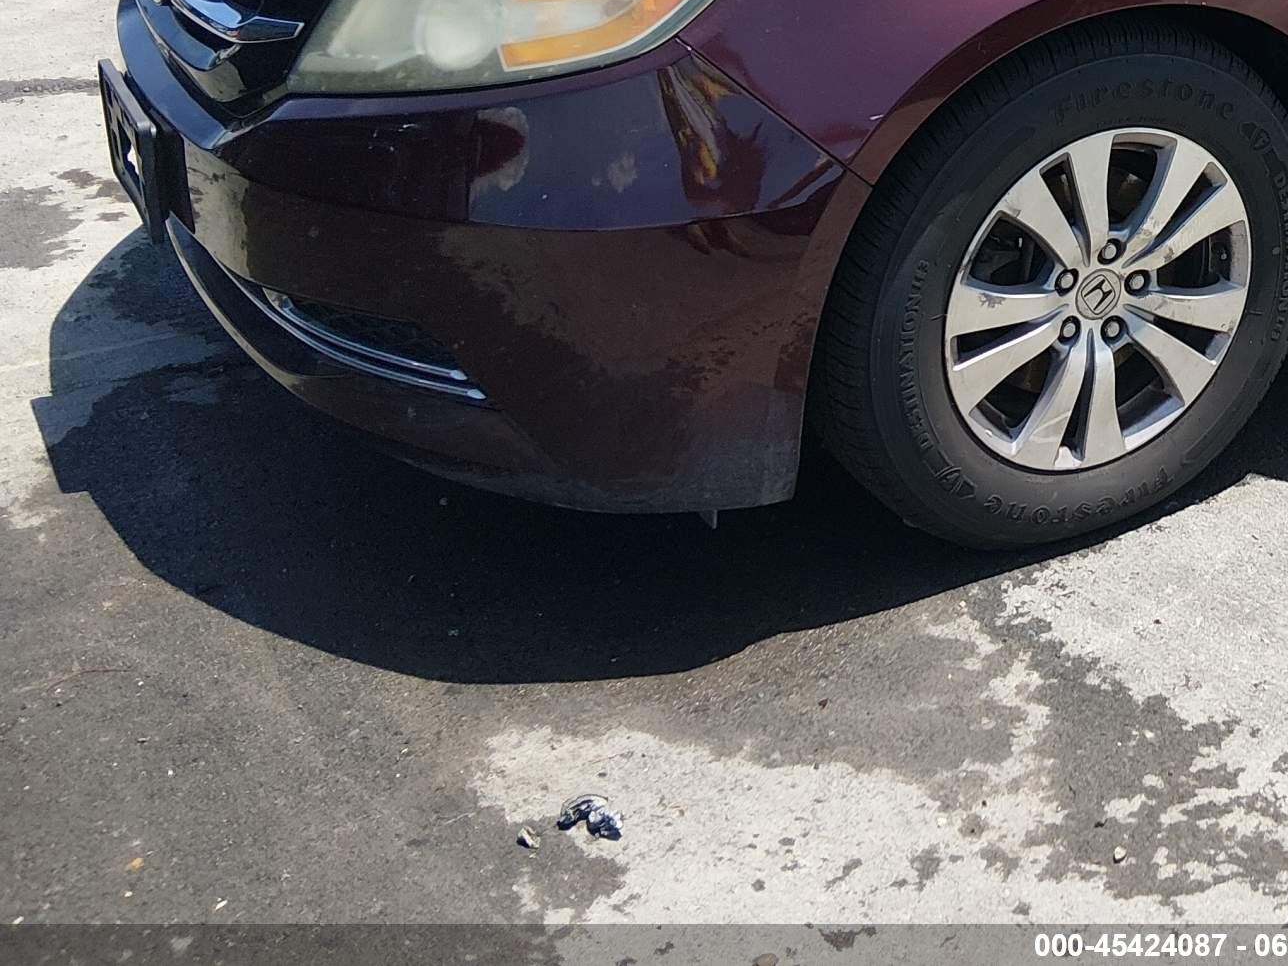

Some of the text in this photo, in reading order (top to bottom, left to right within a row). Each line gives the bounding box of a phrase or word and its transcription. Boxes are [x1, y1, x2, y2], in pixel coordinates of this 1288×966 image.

[1052, 77, 1234, 122] Firestone
[896, 291, 935, 451] DESTINATION
[983, 466, 1175, 524] Firestone
